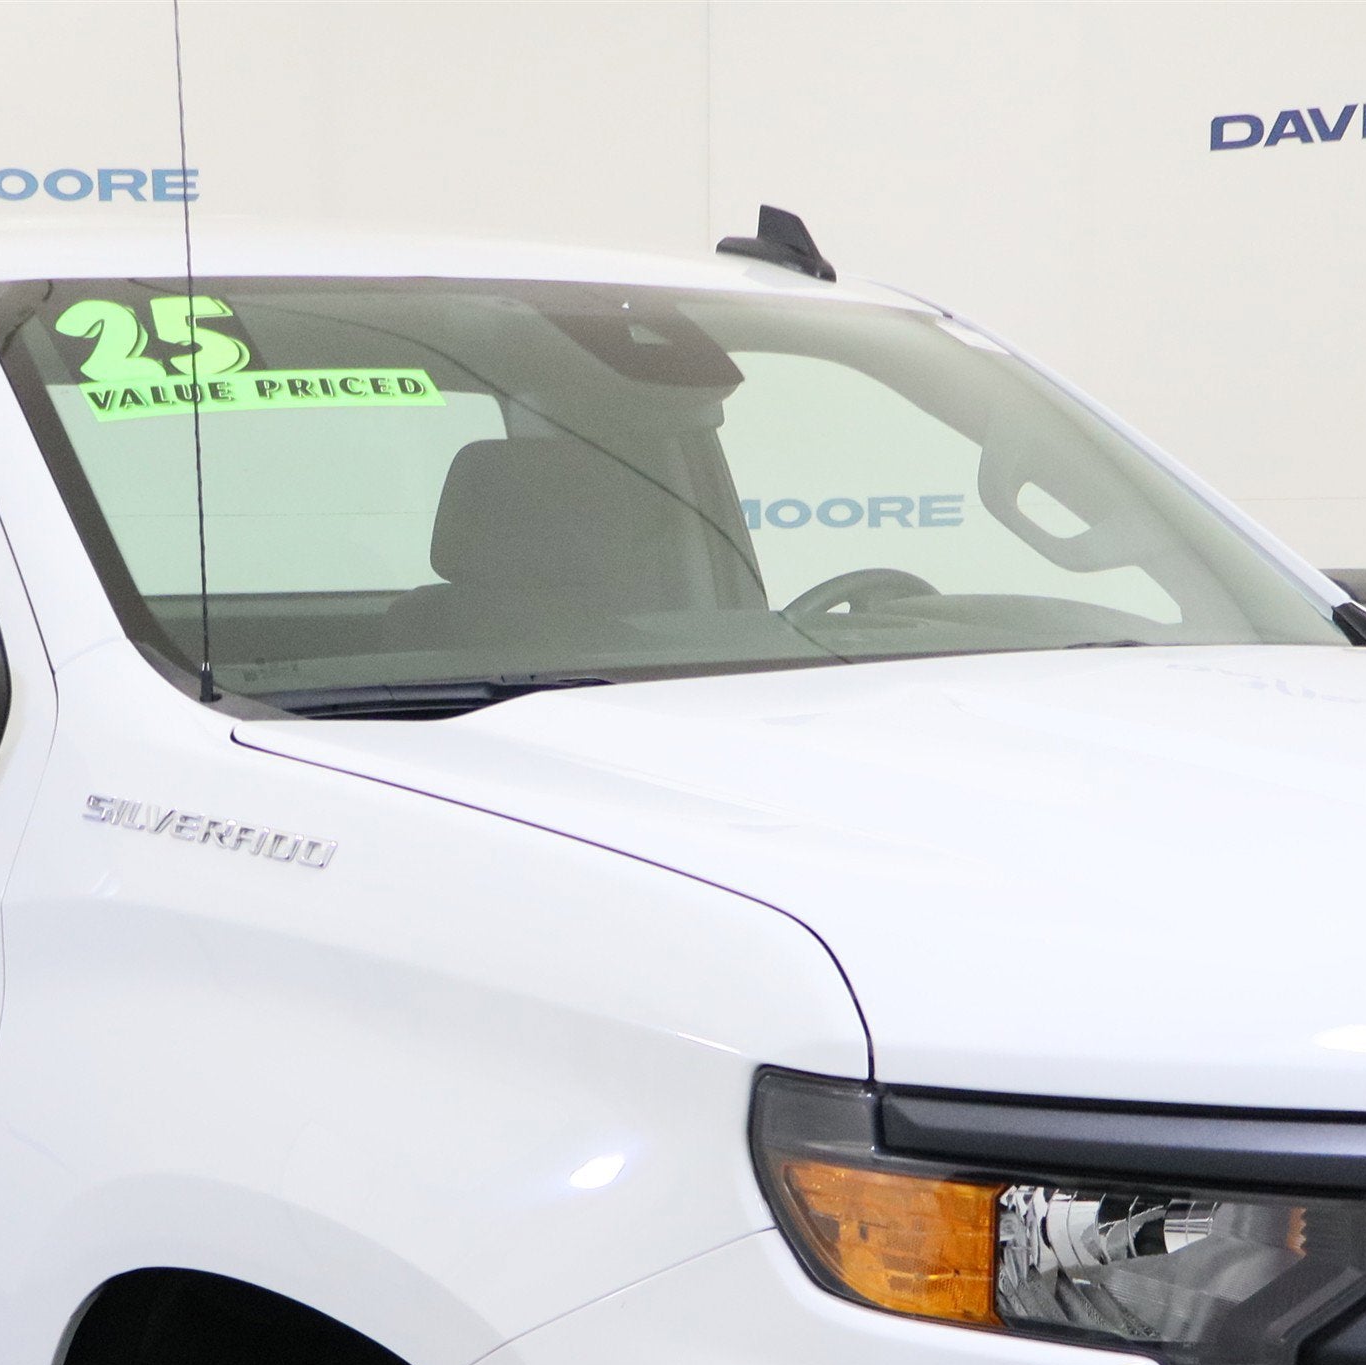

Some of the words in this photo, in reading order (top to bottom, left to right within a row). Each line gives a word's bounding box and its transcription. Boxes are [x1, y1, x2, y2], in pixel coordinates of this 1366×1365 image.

[55, 295, 252, 382] 25
[87, 381, 236, 411] VALUE
[254, 376, 427, 400] PRICED
[83, 794, 339, 869] SILVERADO
